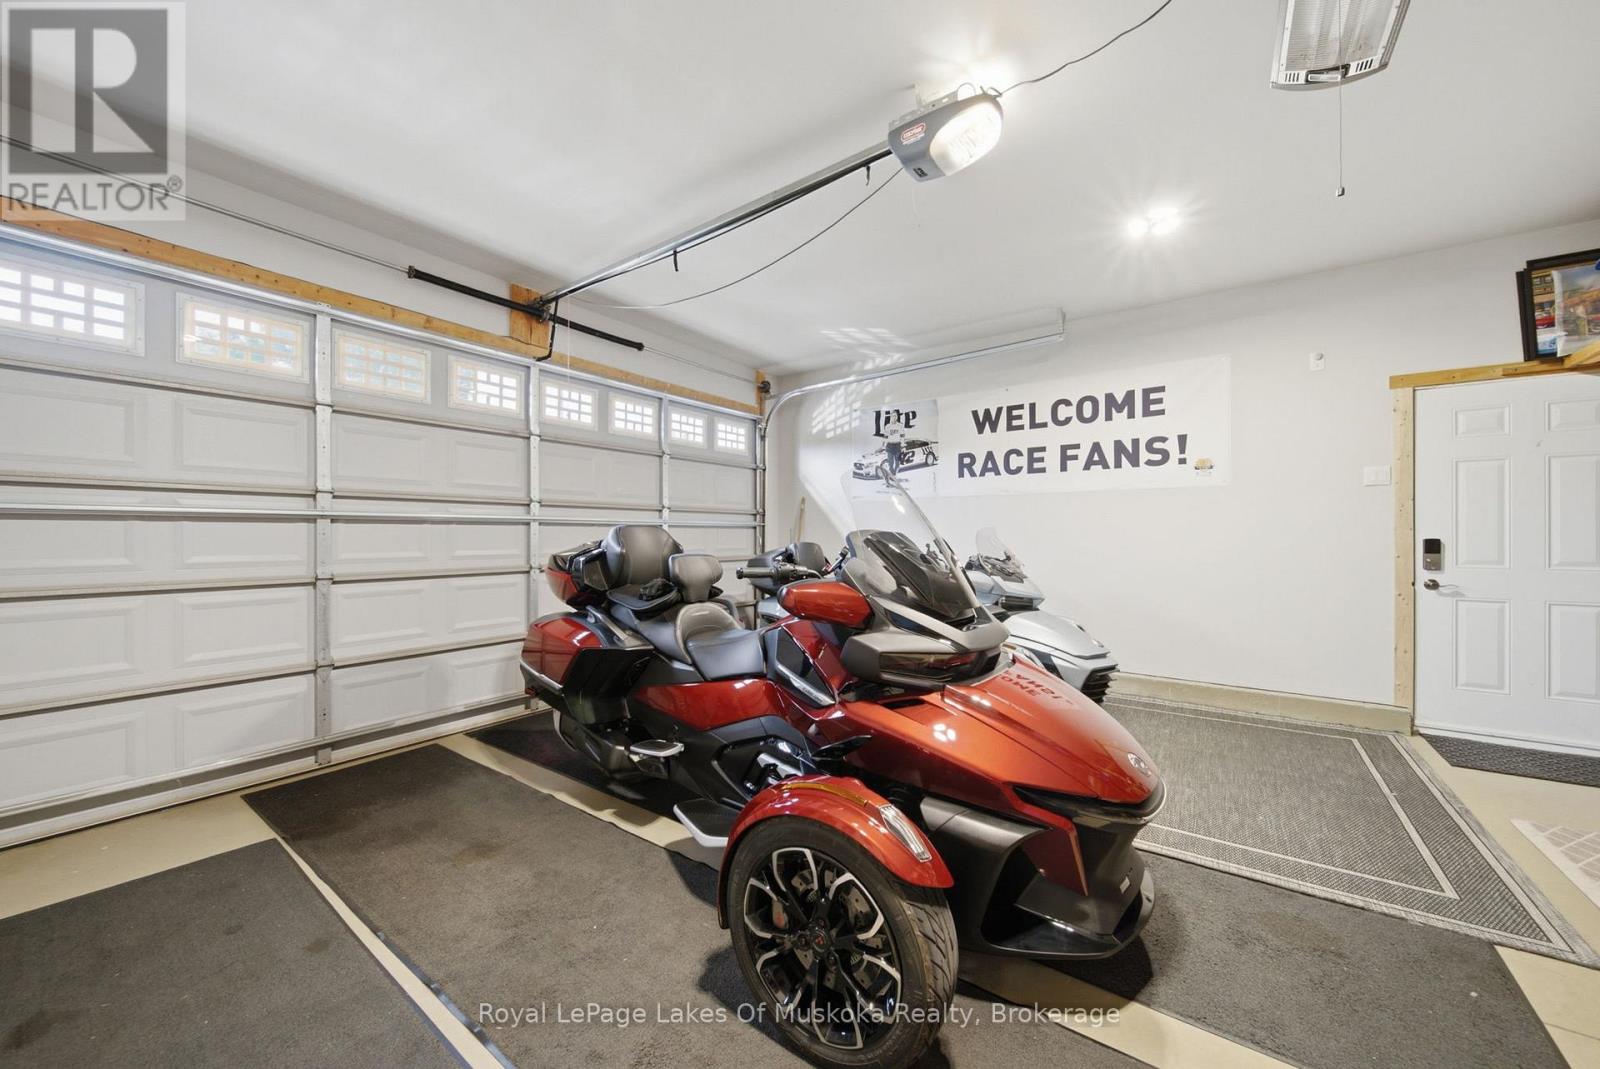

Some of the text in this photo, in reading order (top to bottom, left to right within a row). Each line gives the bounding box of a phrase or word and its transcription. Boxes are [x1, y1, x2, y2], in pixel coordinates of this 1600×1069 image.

[971, 385, 1166, 435] WELCOME
[957, 446, 1047, 478] RACE
[1059, 434, 1188, 473] FANS!
